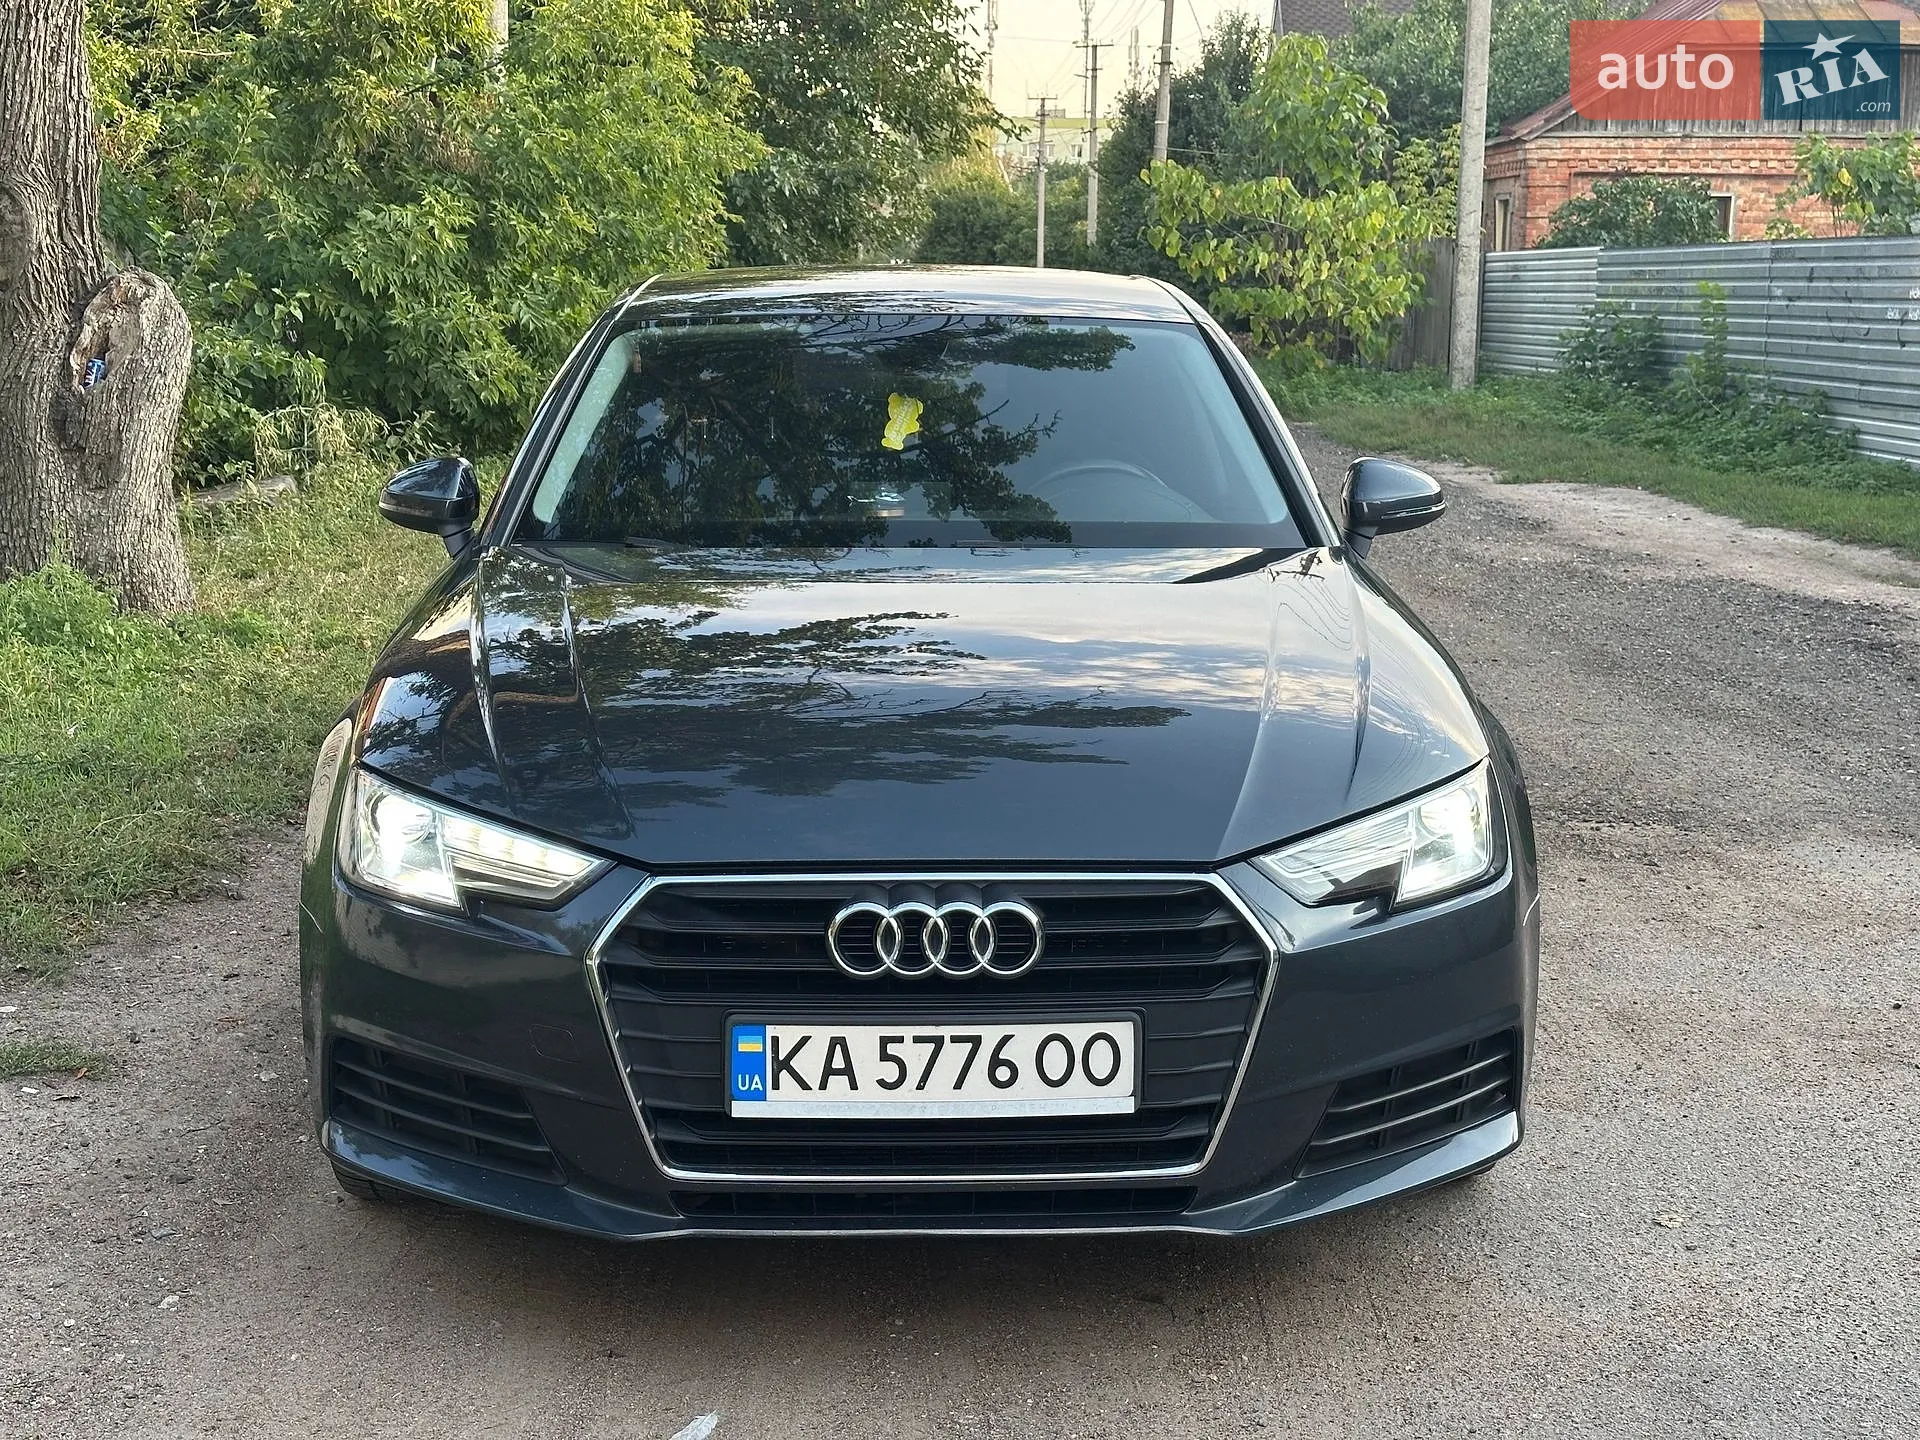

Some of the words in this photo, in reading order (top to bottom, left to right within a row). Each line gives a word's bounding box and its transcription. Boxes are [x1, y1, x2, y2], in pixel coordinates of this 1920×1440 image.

[770, 1034, 859, 1091] KA
[875, 1033, 1020, 1091] 5776
[1034, 1031, 1122, 1089] OO
[737, 1074, 764, 1091] UA
